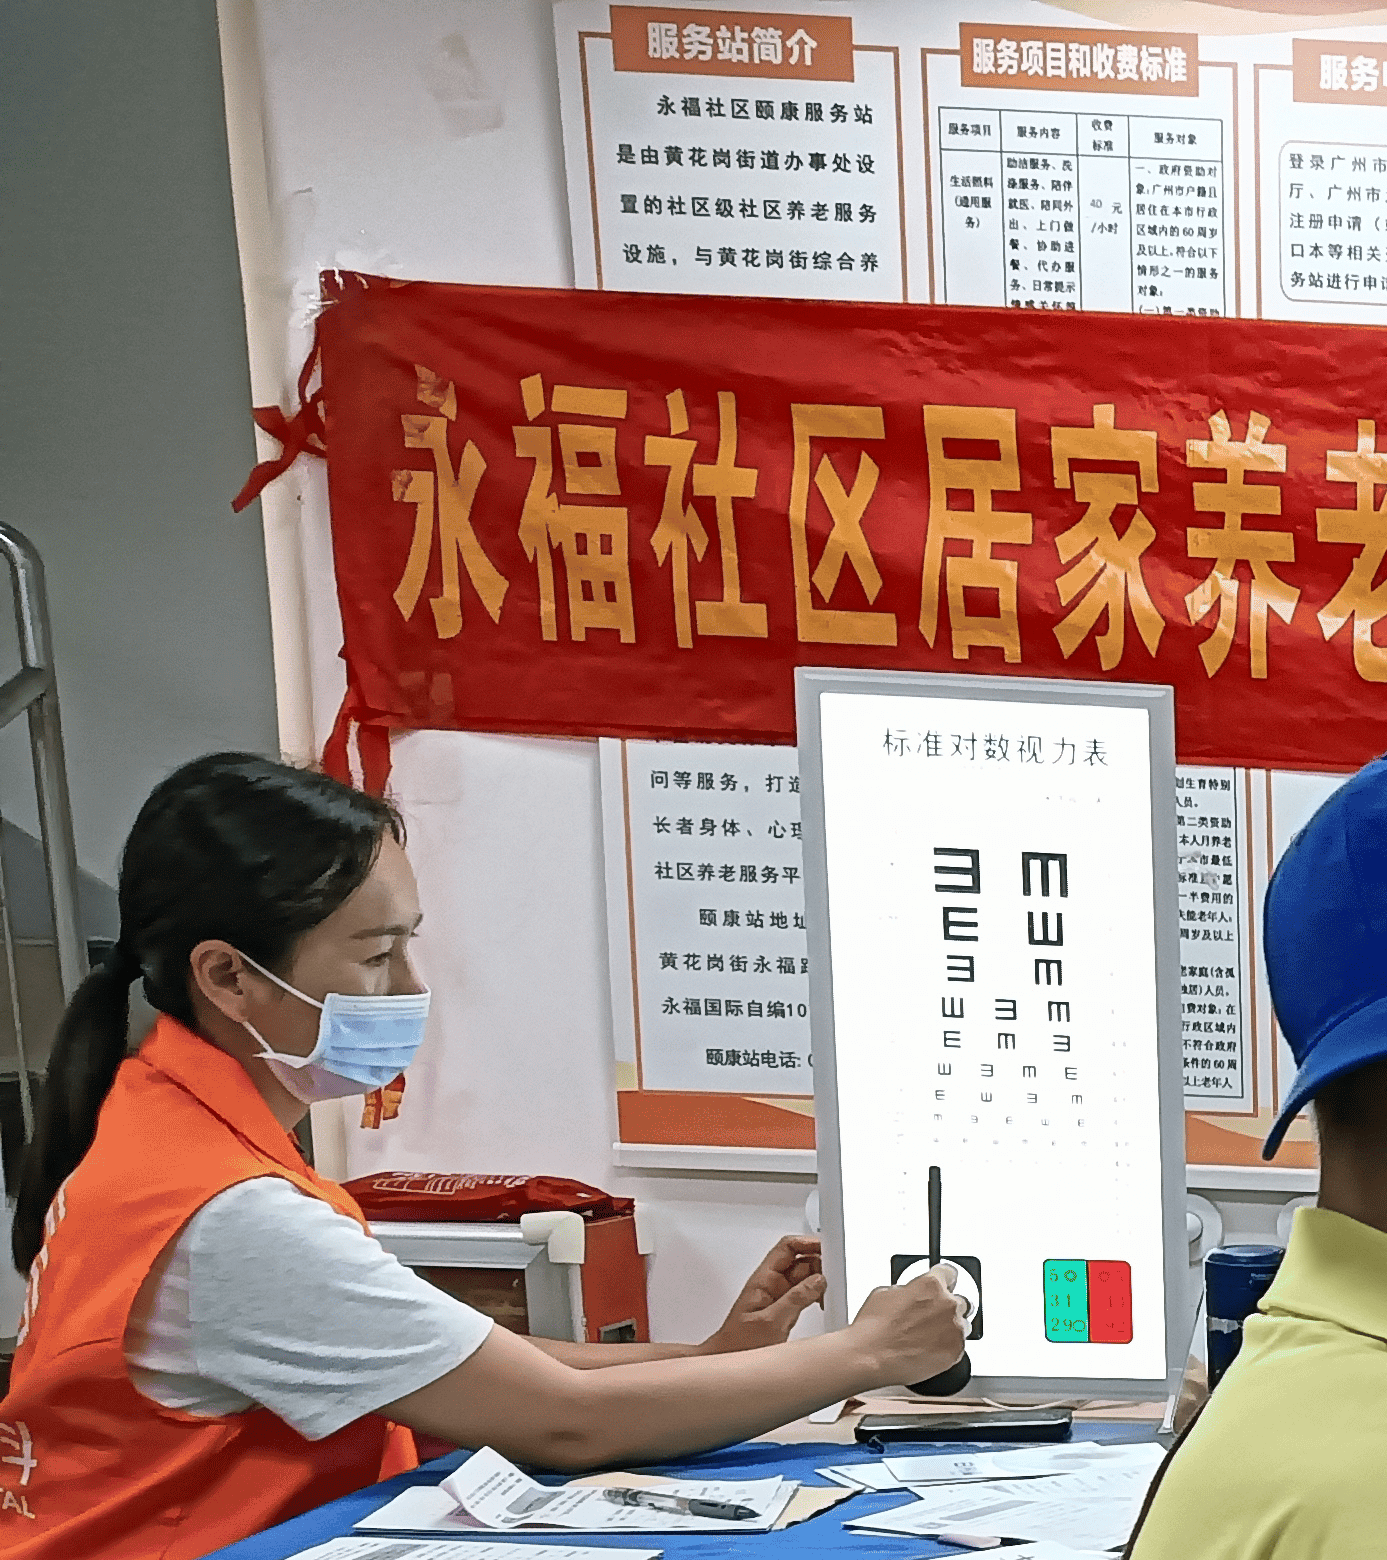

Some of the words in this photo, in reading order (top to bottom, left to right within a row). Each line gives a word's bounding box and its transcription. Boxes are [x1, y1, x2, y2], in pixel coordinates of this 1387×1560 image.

[647, 22, 818, 66] 服务站简介
[970, 37, 1188, 85] 服务项目和收费标准
[656, 94, 874, 125] 永福社区颐康服务站
[1153, 131, 1197, 146] 服务对象
[616, 143, 875, 175] 是由黄花岗街道办事处设
[620, 193, 877, 224] 置的社区级社区养老服务
[622, 242, 879, 274] 设施，与黄花岗街综合养
[881, 727, 1110, 767] 标准对数视力表
[654, 860, 801, 885] 社区养老服务平
[662, 995, 808, 1020] 永福国际自编10
